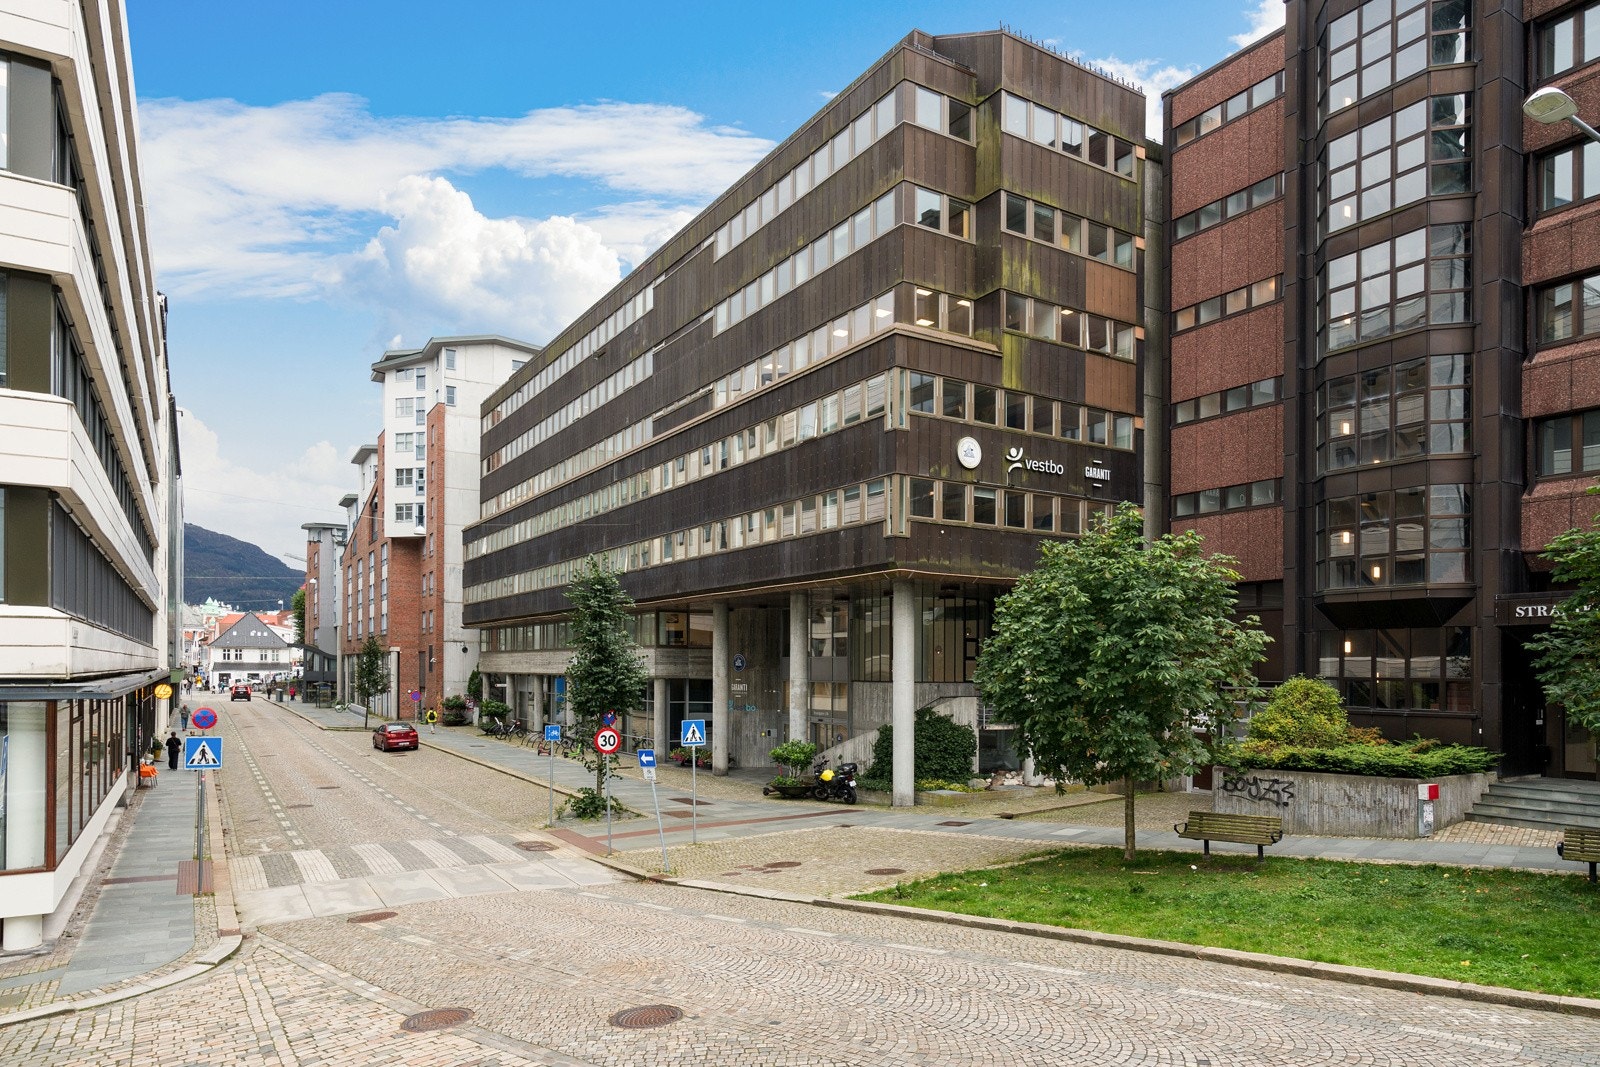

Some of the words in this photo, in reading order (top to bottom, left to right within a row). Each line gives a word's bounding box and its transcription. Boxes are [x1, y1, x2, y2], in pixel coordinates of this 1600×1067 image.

[1025, 459, 1064, 475] vestbo
[1085, 466, 1111, 481] GARANTI
[600, 734, 616, 747] 30
